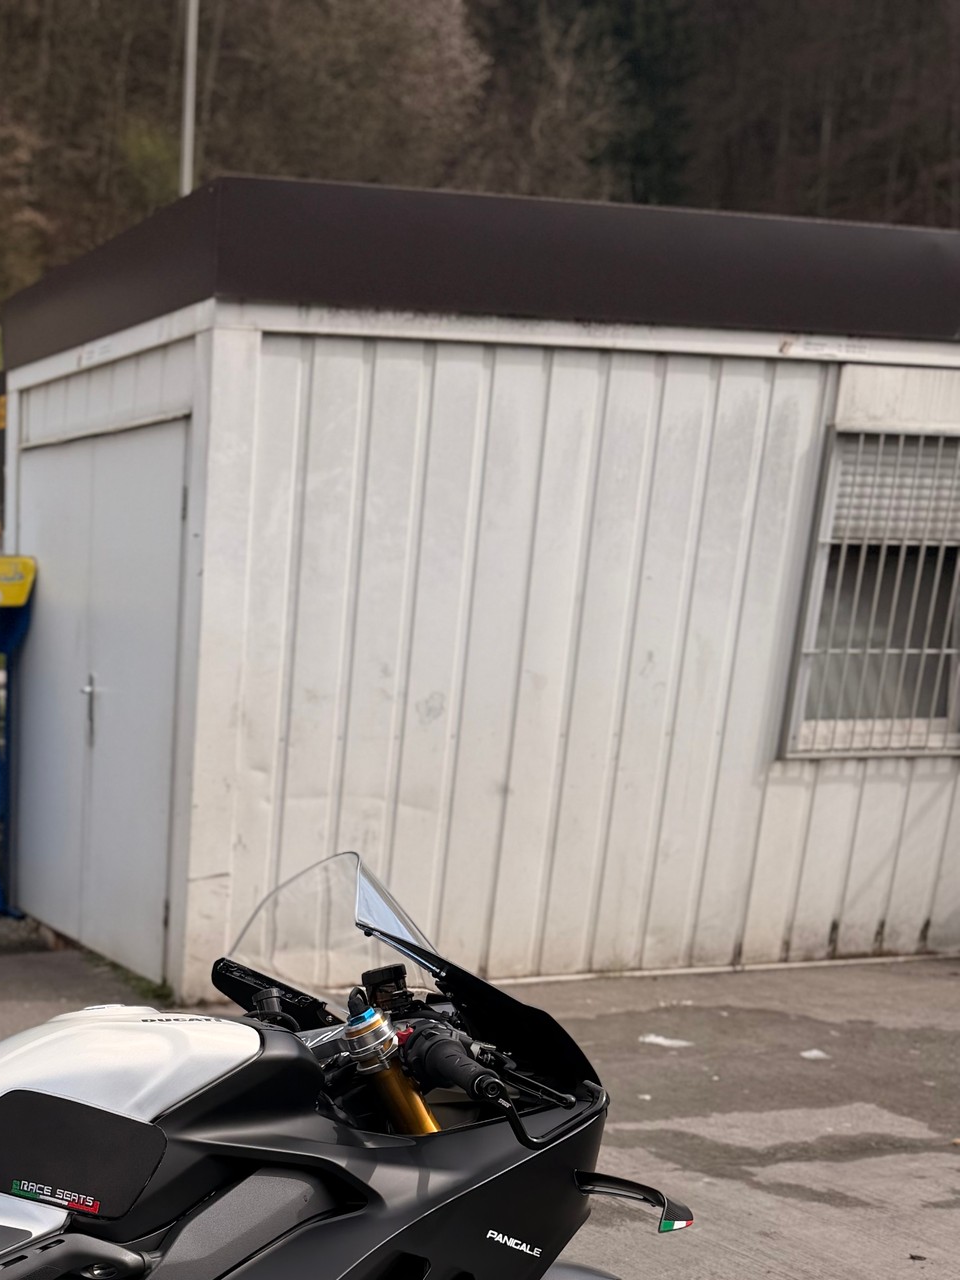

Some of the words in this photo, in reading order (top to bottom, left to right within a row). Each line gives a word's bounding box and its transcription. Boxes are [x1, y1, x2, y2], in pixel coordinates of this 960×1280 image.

[20, 1180, 53, 1196] RACE
[55, 1188, 95, 1206] SEATS
[486, 1229, 543, 1257] PANIGALE
